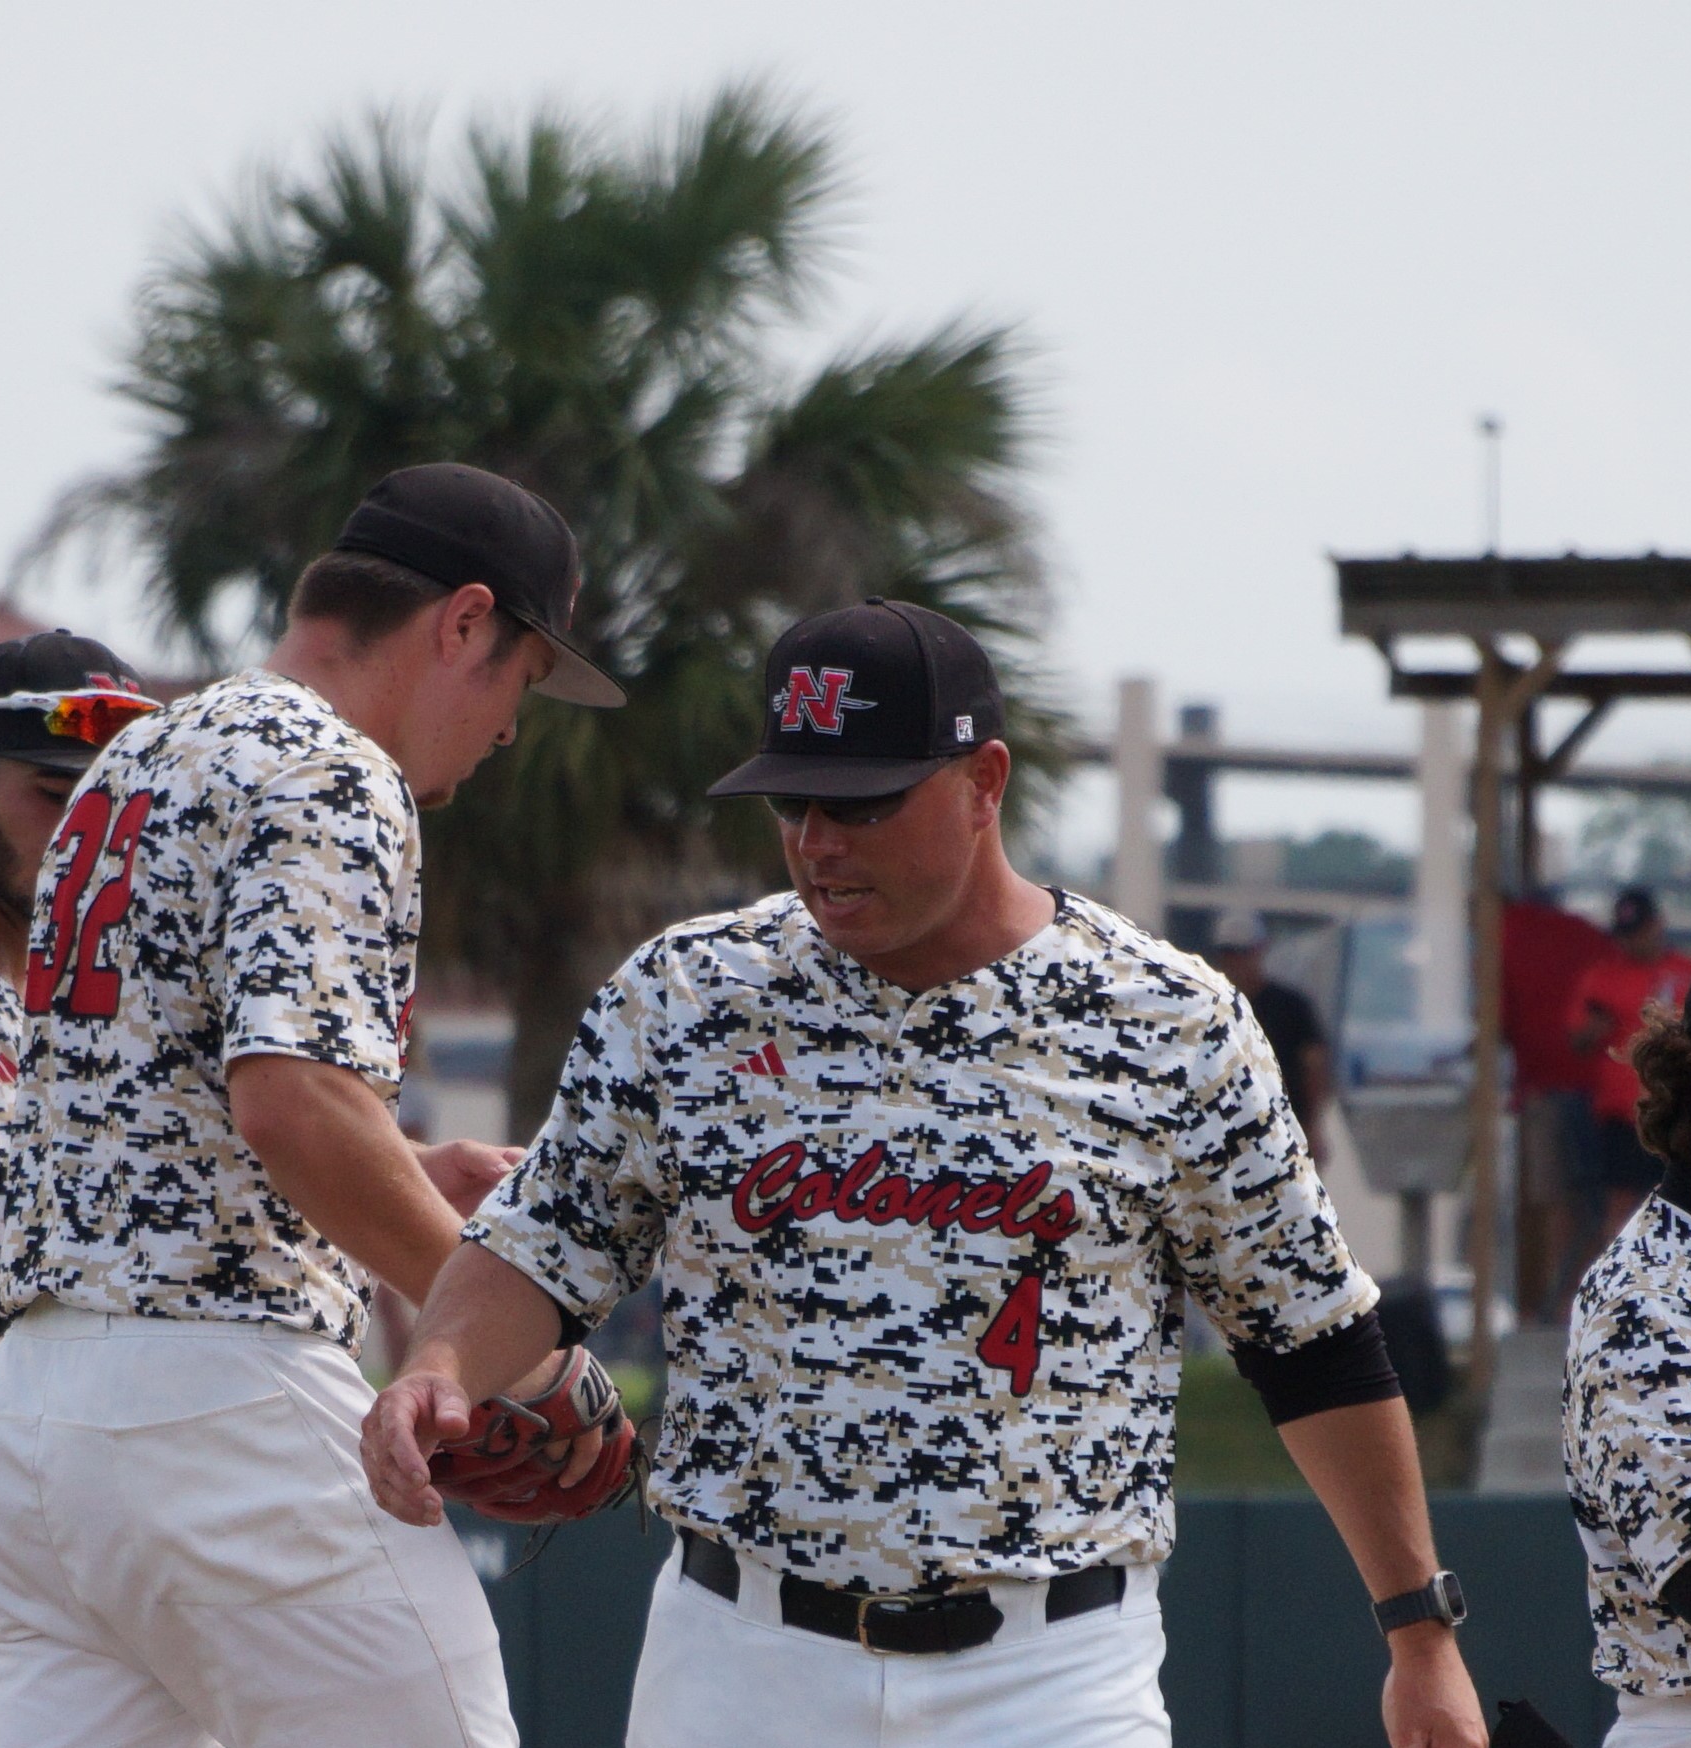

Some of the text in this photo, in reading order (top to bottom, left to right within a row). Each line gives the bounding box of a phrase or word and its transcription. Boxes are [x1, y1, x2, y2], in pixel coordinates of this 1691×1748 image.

[780, 666, 854, 736] N
[24, 787, 154, 1020] 32
[732, 1140, 1083, 1242] Colonels
[976, 1272, 1043, 1398] 4
